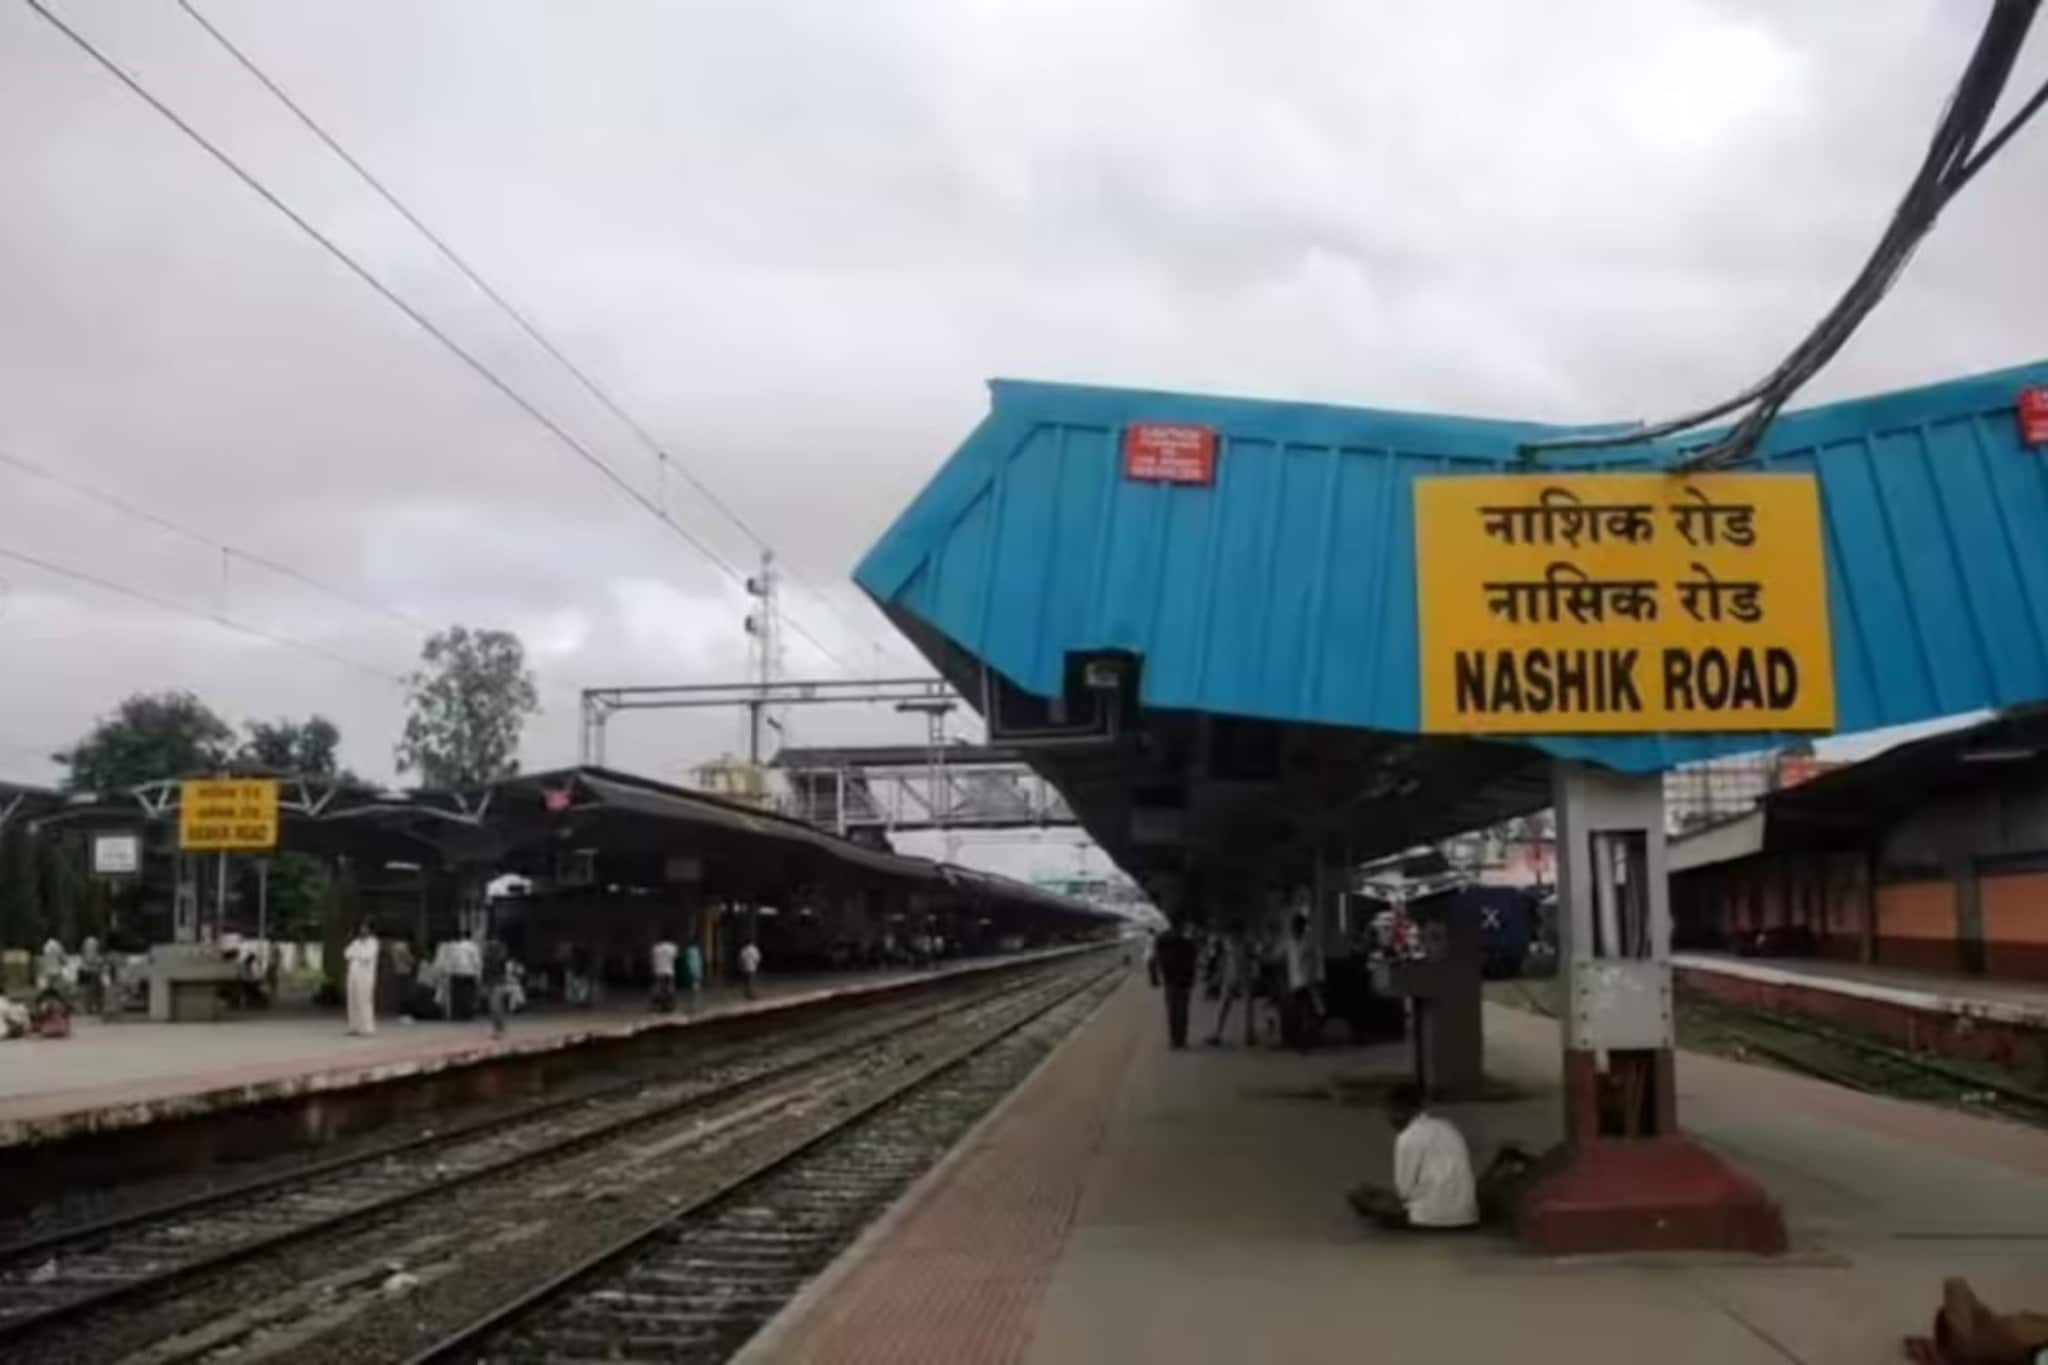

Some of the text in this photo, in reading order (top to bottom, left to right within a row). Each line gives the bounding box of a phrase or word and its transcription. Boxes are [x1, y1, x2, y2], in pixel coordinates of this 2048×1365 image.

[1479, 487, 1757, 548] नाशिक रोड
[1482, 561, 1763, 624] नासिक रोड
[1455, 647, 1799, 714] NASHIK ROAD
